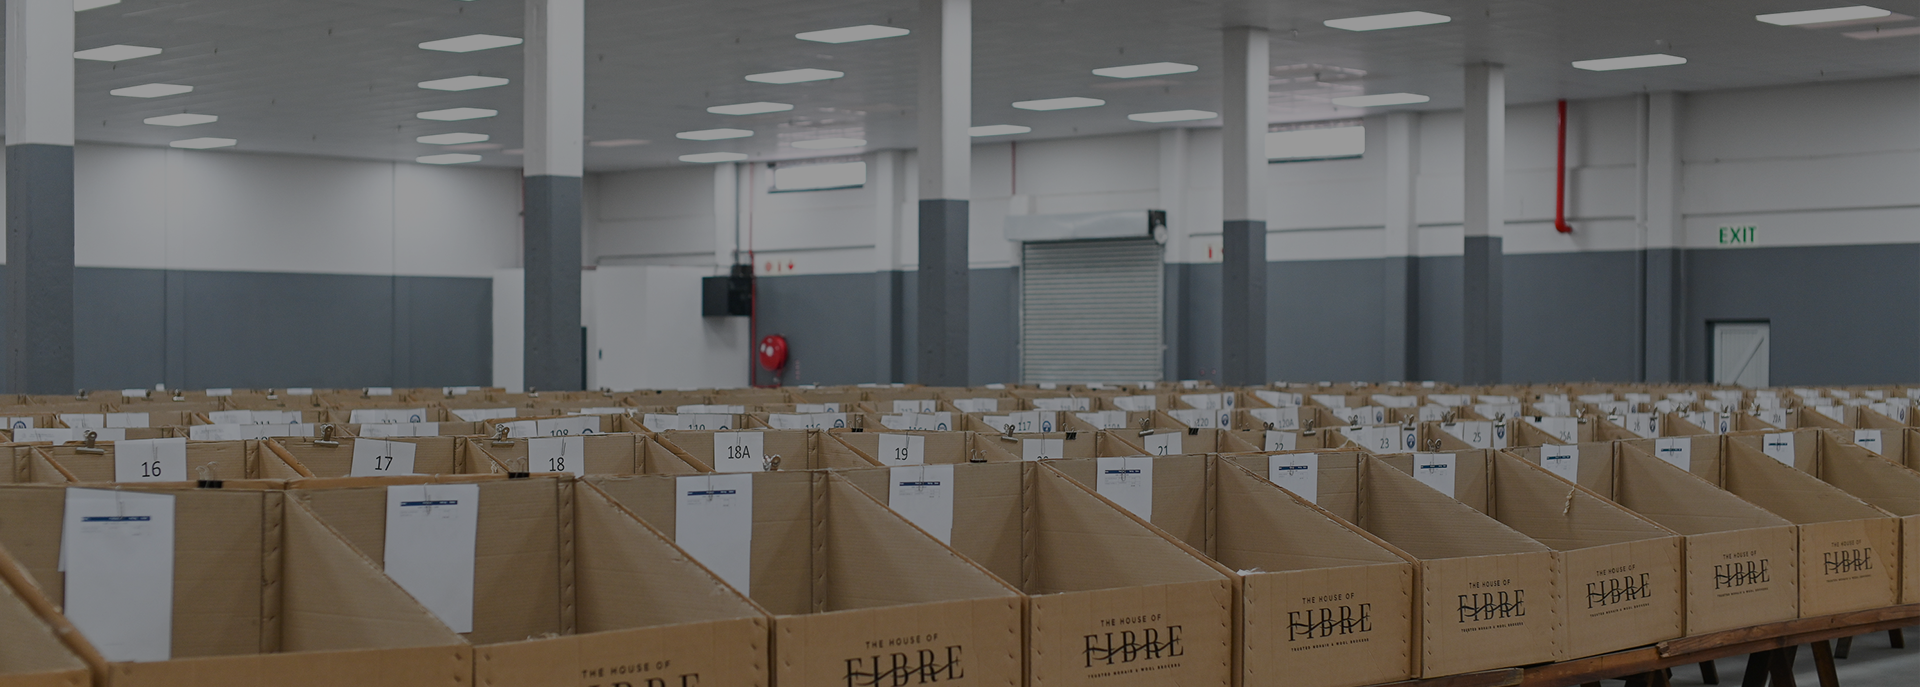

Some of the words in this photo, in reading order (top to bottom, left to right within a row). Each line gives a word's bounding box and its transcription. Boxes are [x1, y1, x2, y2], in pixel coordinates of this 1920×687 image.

[1719, 226, 1757, 243] EXIT
[1018, 421, 1031, 431] 117
[1380, 438, 1389, 449] 23
[1473, 432, 1481, 442] 25
[728, 446, 750, 459] 18A
[895, 448, 908, 460] 19
[1158, 445, 1168, 455] 21
[141, 460, 162, 477] 16
[374, 455, 392, 470] 17
[549, 457, 564, 471] 18
[1824, 548, 1872, 575] FIBRE
[1608, 566, 1626, 574] HOUSE
[1714, 558, 1770, 589] FIBRE
[1319, 594, 1342, 602] HOUSE
[1346, 592, 1354, 600] OF
[1586, 572, 1651, 609] FIBRE
[1458, 590, 1525, 623] FIBRE
[1100, 618, 1115, 627] THE
[1120, 615, 1146, 625] HOUSE
[1287, 603, 1371, 642] FIBRE
[866, 640, 883, 649] THE
[889, 635, 920, 646] HOUSE
[926, 633, 938, 642] OF
[1082, 625, 1183, 668] FIBRE
[582, 668, 604, 678] THE
[610, 662, 649, 675] HOUSE
[656, 660, 670, 670] OF
[844, 645, 964, 687] FIBRE
